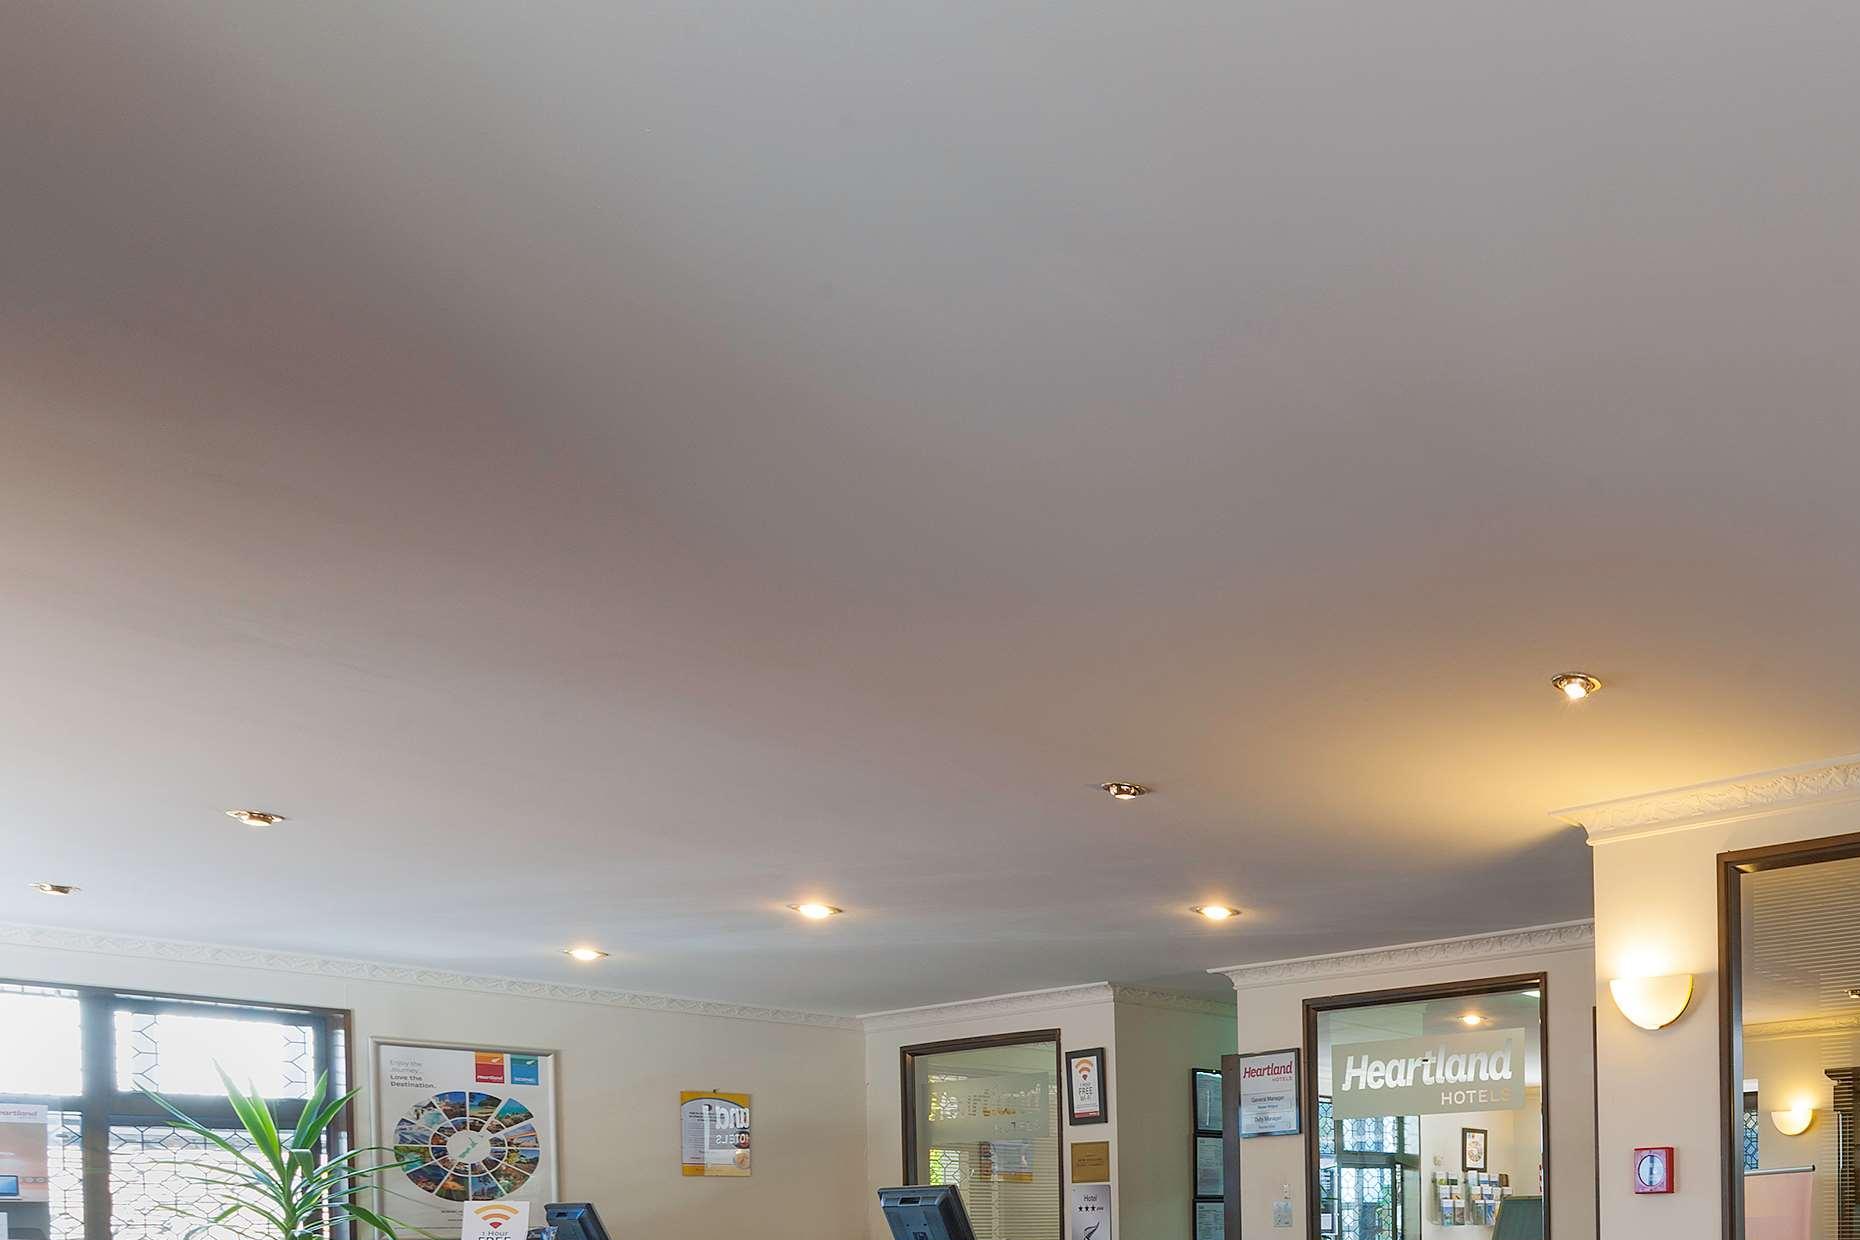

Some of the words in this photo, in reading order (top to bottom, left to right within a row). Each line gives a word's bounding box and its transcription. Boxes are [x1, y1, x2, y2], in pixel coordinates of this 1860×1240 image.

[1243, 1061, 1294, 1079] Heartland
[1341, 1037, 1513, 1092] Heartland
[1441, 1087, 1512, 1105] HOTELS
